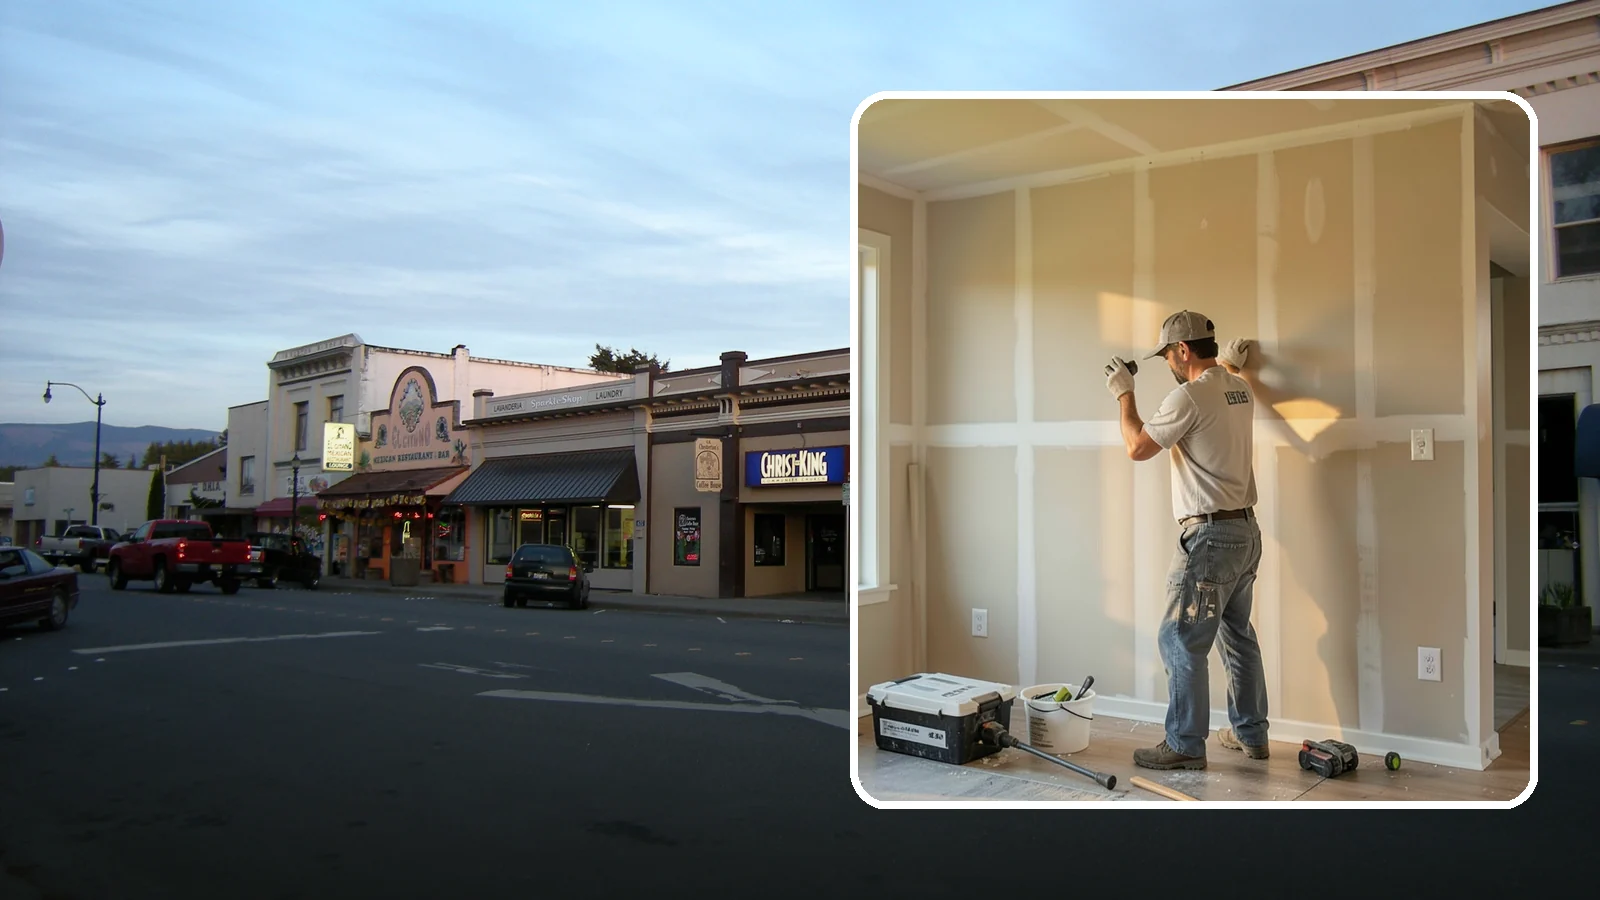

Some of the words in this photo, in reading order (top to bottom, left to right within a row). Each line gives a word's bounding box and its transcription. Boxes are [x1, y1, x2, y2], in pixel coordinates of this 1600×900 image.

[595, 389, 624, 400] LAUNDRY
[493, 402, 522, 412] LAVANDERIA
[392, 425, 401, 449] EL
[373, 454, 396, 464] MEXICAN
[397, 451, 434, 463] RESTAURANT
[437, 450, 450, 459] BAR
[761, 452, 797, 478] CHRIST
[799, 450, 827, 476] KING
